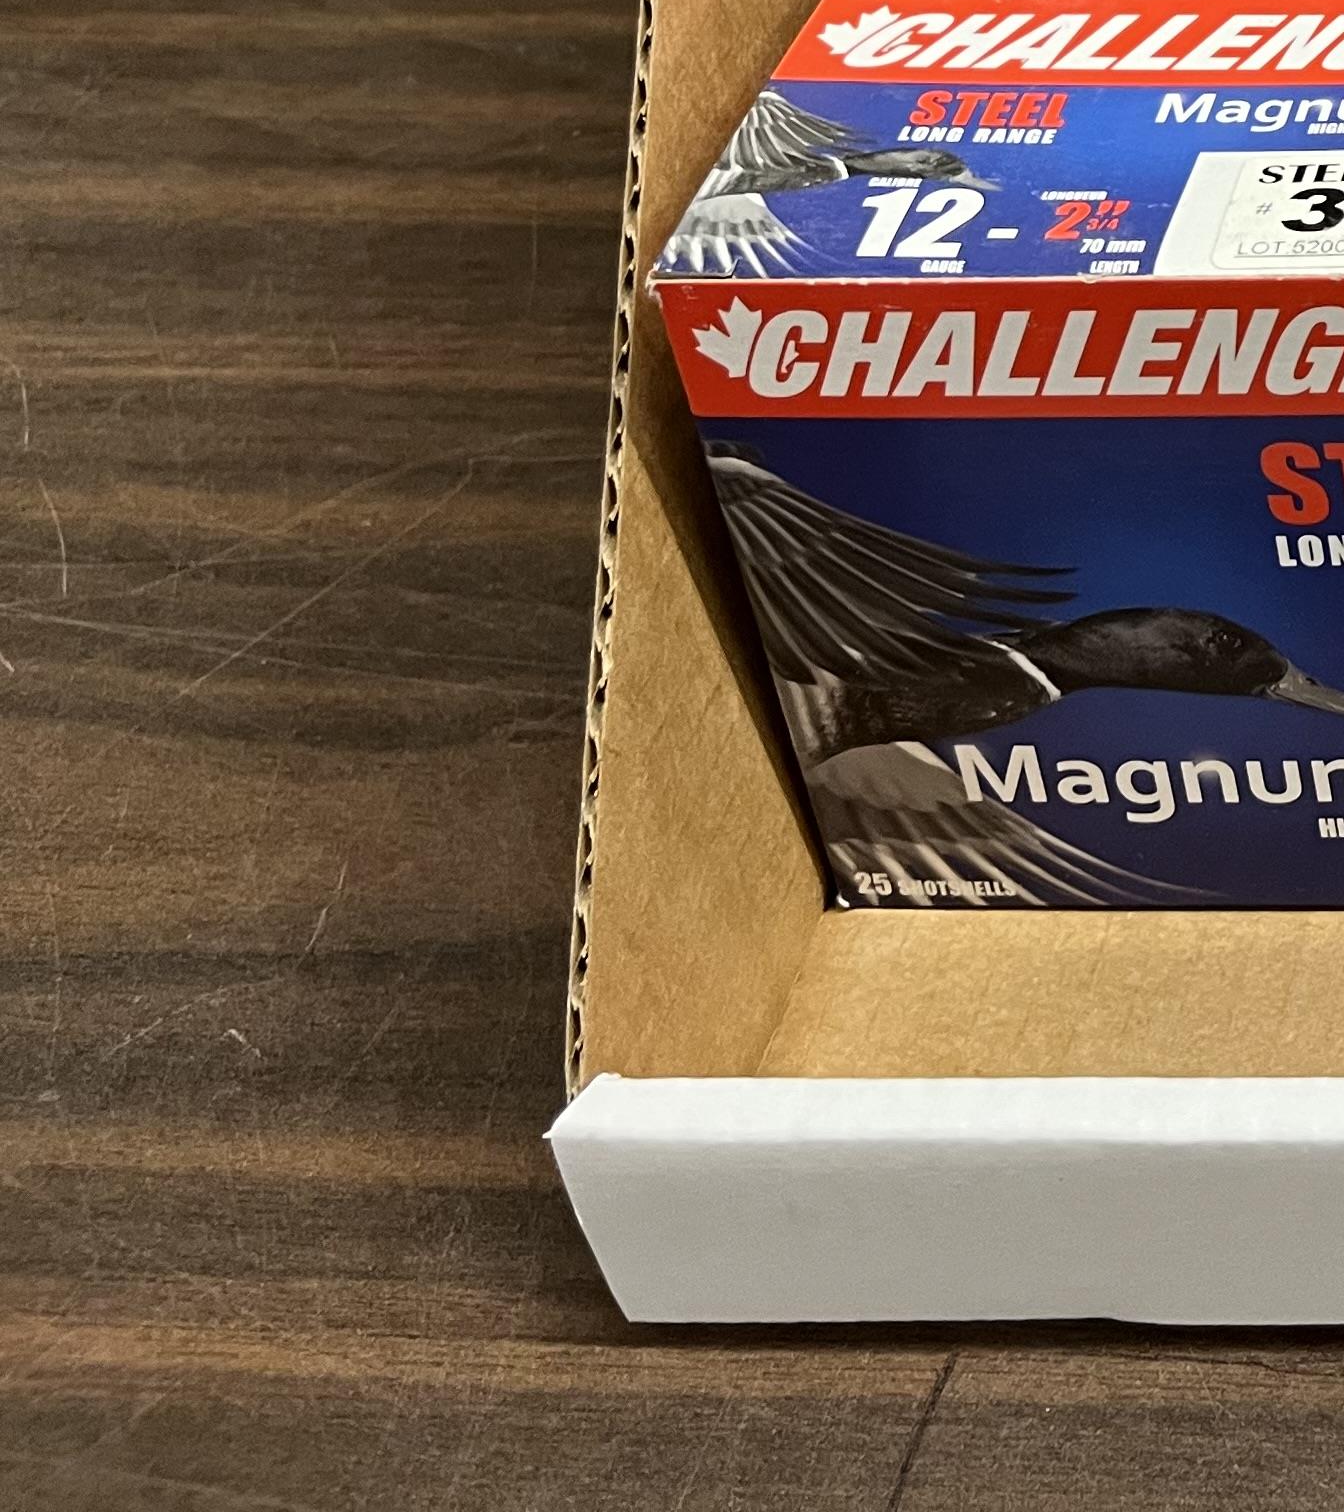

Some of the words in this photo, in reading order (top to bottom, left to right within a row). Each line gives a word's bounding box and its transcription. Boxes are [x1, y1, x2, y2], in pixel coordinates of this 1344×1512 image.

[908, 90, 1069, 129] STEEL
[897, 125, 966, 144] LONG
[972, 126, 1058, 145] RANGE
[856, 188, 985, 258] 12
[854, 871, 893, 896] 25
[897, 879, 1018, 897] SHOTSHELLS
